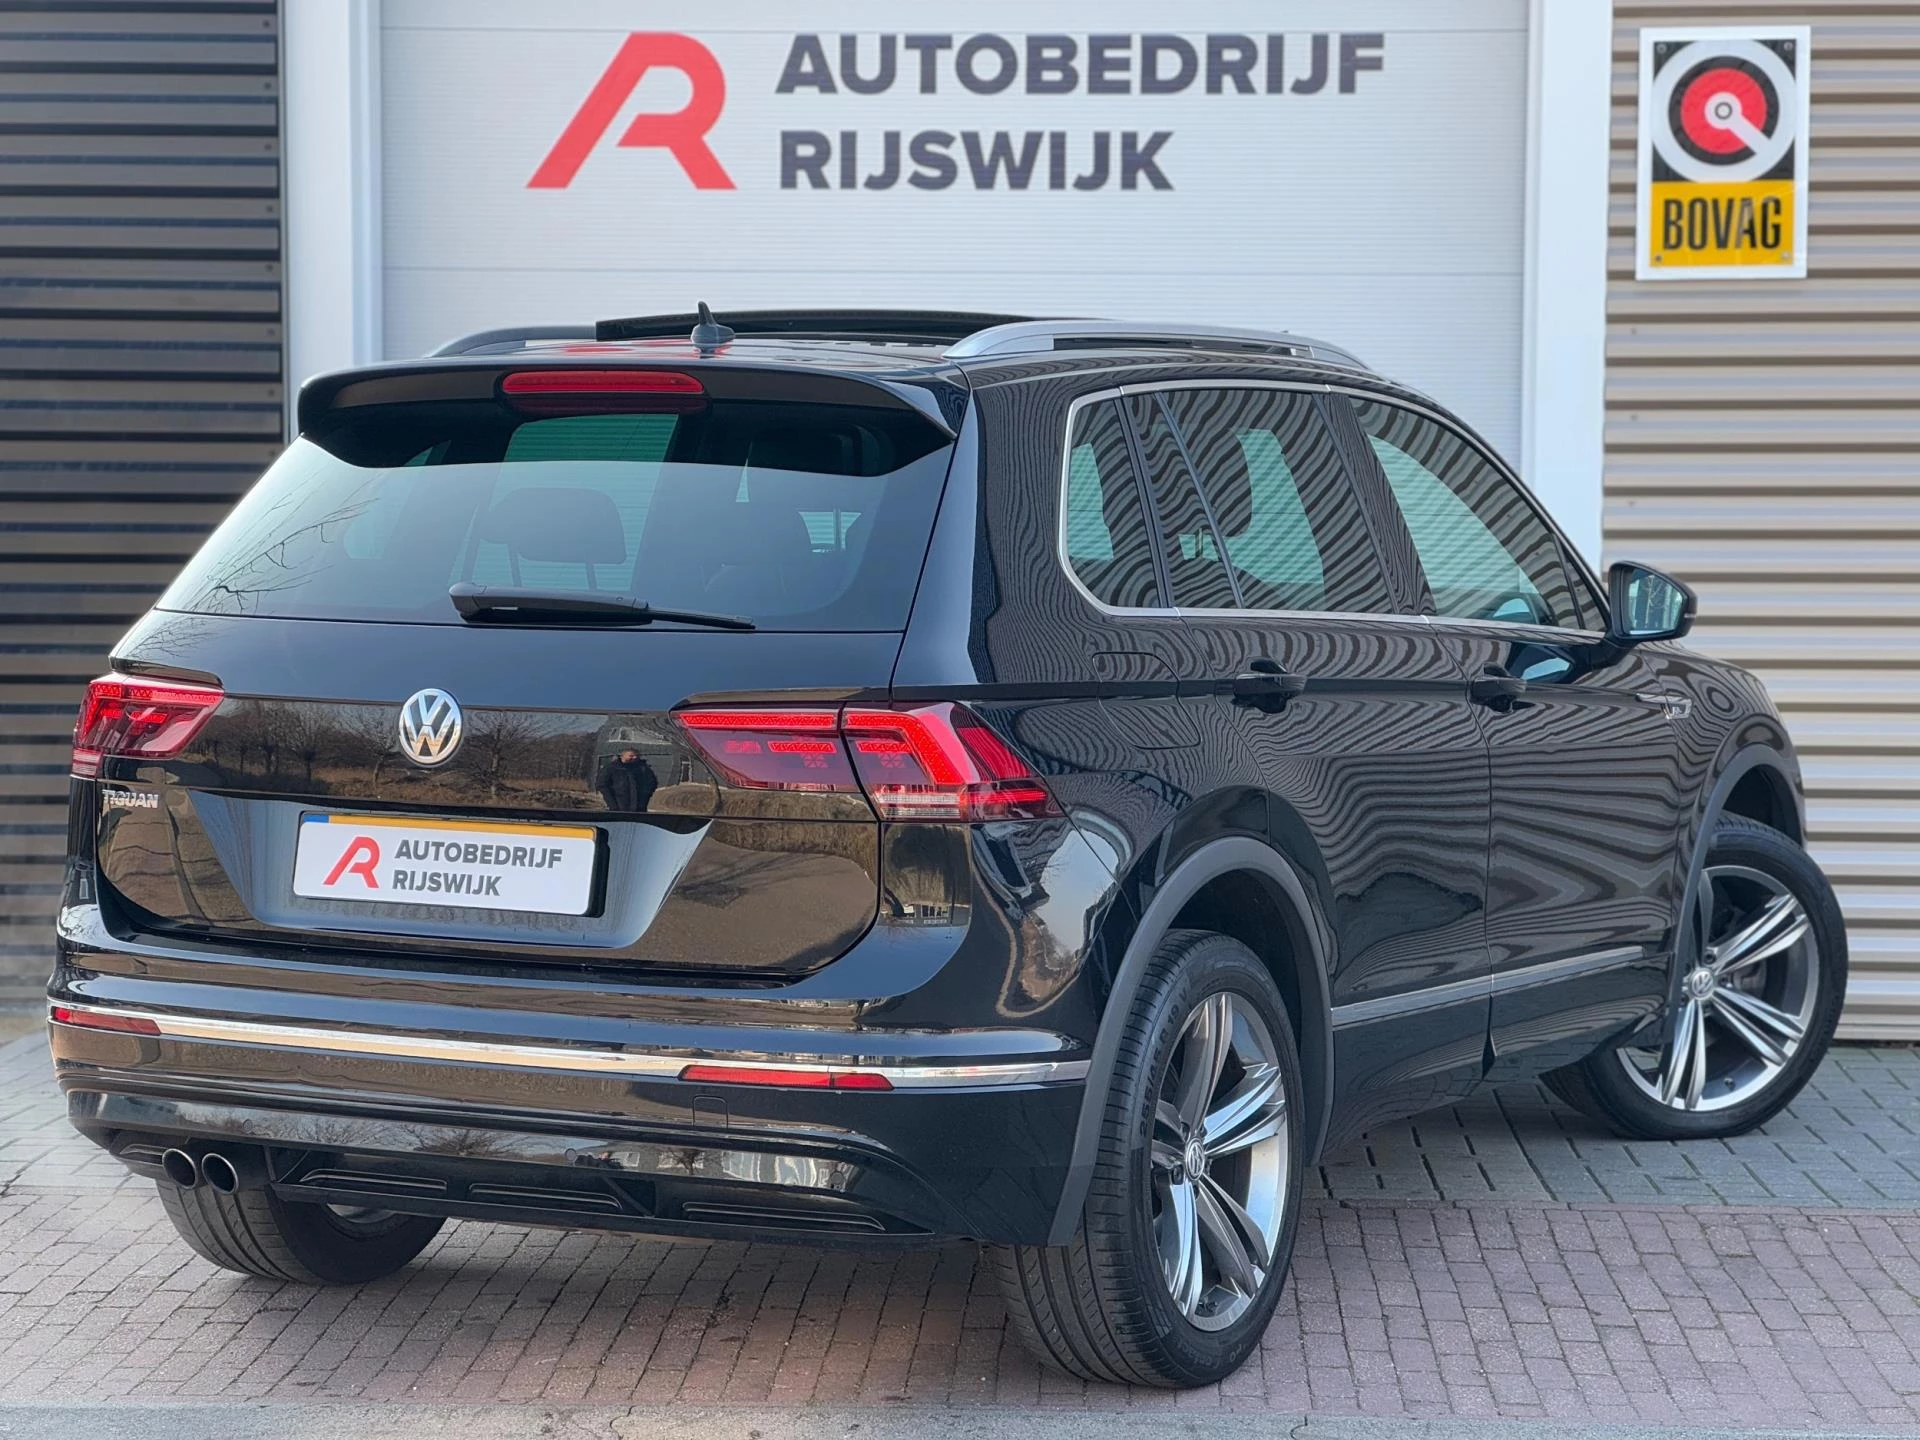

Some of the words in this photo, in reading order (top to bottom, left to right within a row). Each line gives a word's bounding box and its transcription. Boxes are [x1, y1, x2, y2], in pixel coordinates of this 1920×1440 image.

[775, 33, 1385, 95] AUTOBEDRIJF
[780, 130, 1176, 191] RIJSWIJK
[1662, 196, 1782, 251] BOVAG
[101, 788, 160, 809] TIGUAN
[394, 838, 563, 869] AUTOBEDRIJF
[391, 869, 502, 897] RIJSWIJK
